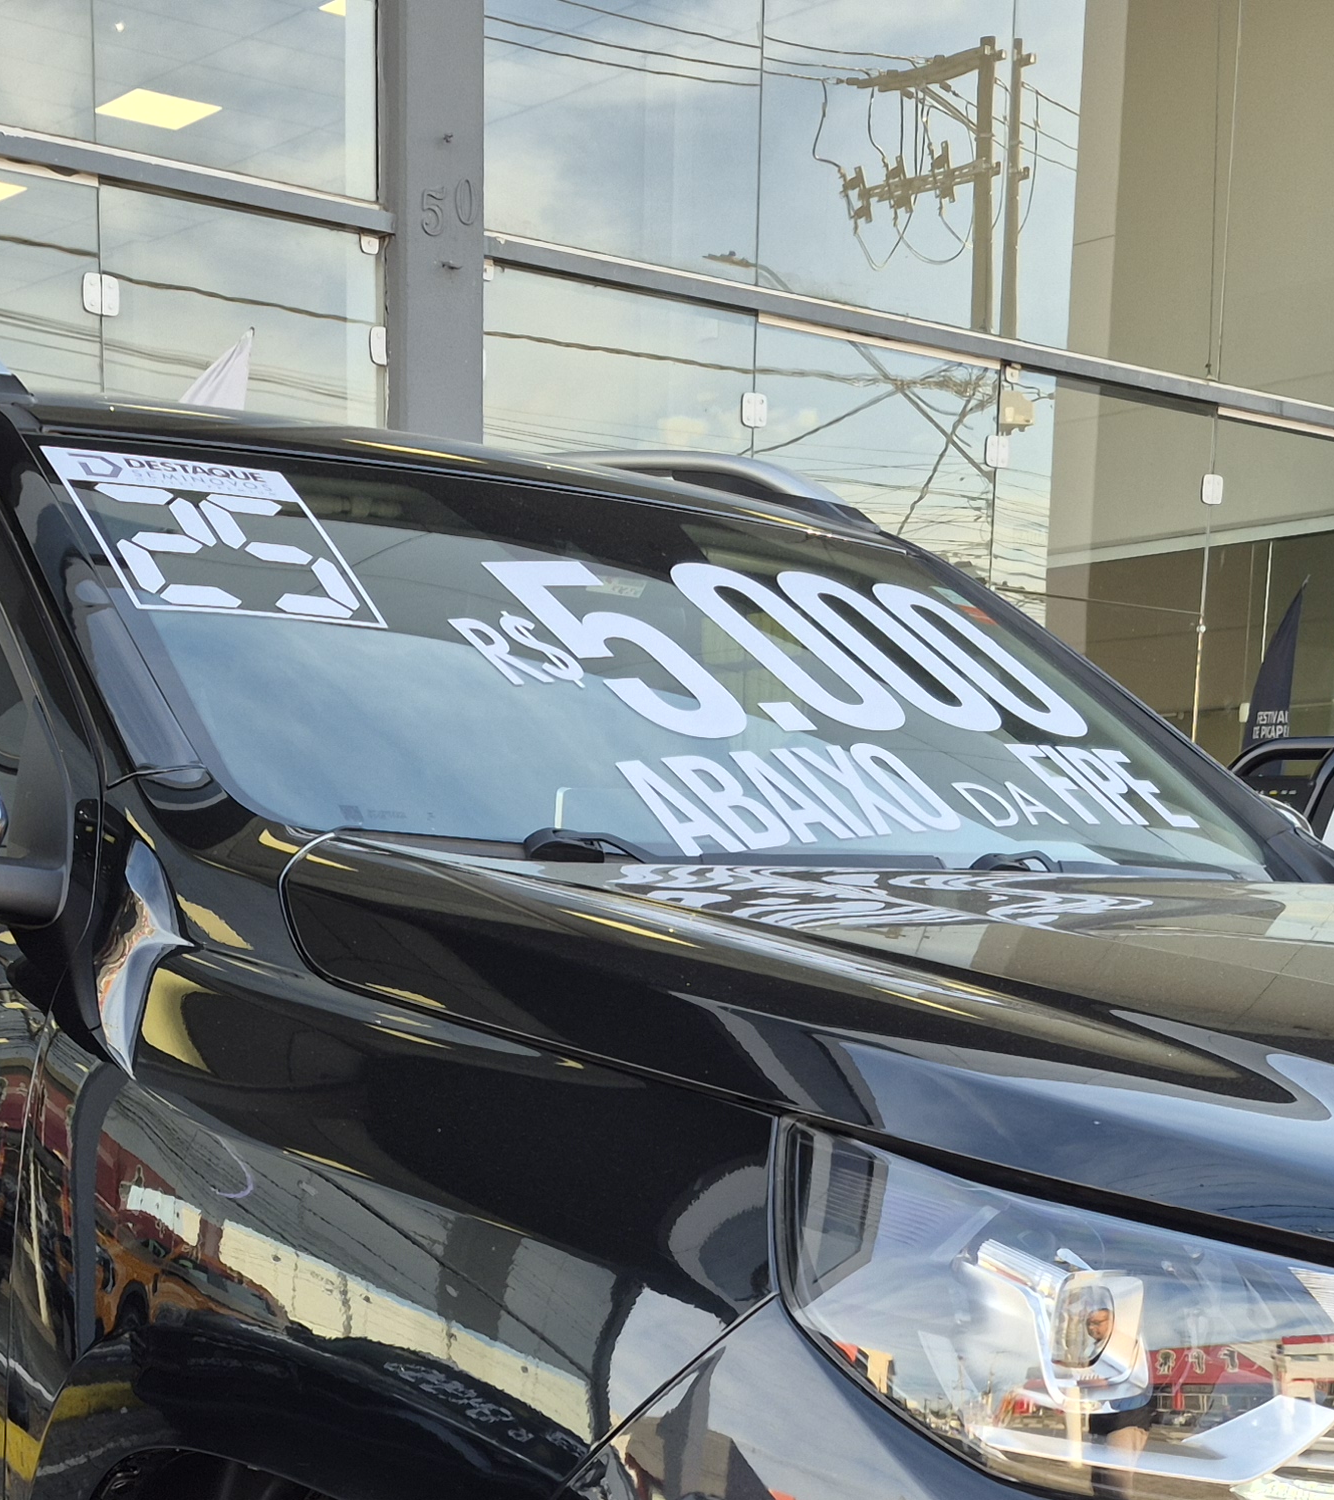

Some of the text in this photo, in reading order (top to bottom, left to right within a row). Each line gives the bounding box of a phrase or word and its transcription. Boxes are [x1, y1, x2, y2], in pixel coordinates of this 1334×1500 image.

[421, 178, 476, 237] 50
[123, 457, 266, 483] DESTAQUE
[131, 469, 273, 492] SEMINOVOS
[481, 560, 1088, 739] 5.000
[615, 742, 1199, 857] ABAIXO DA FIPE
